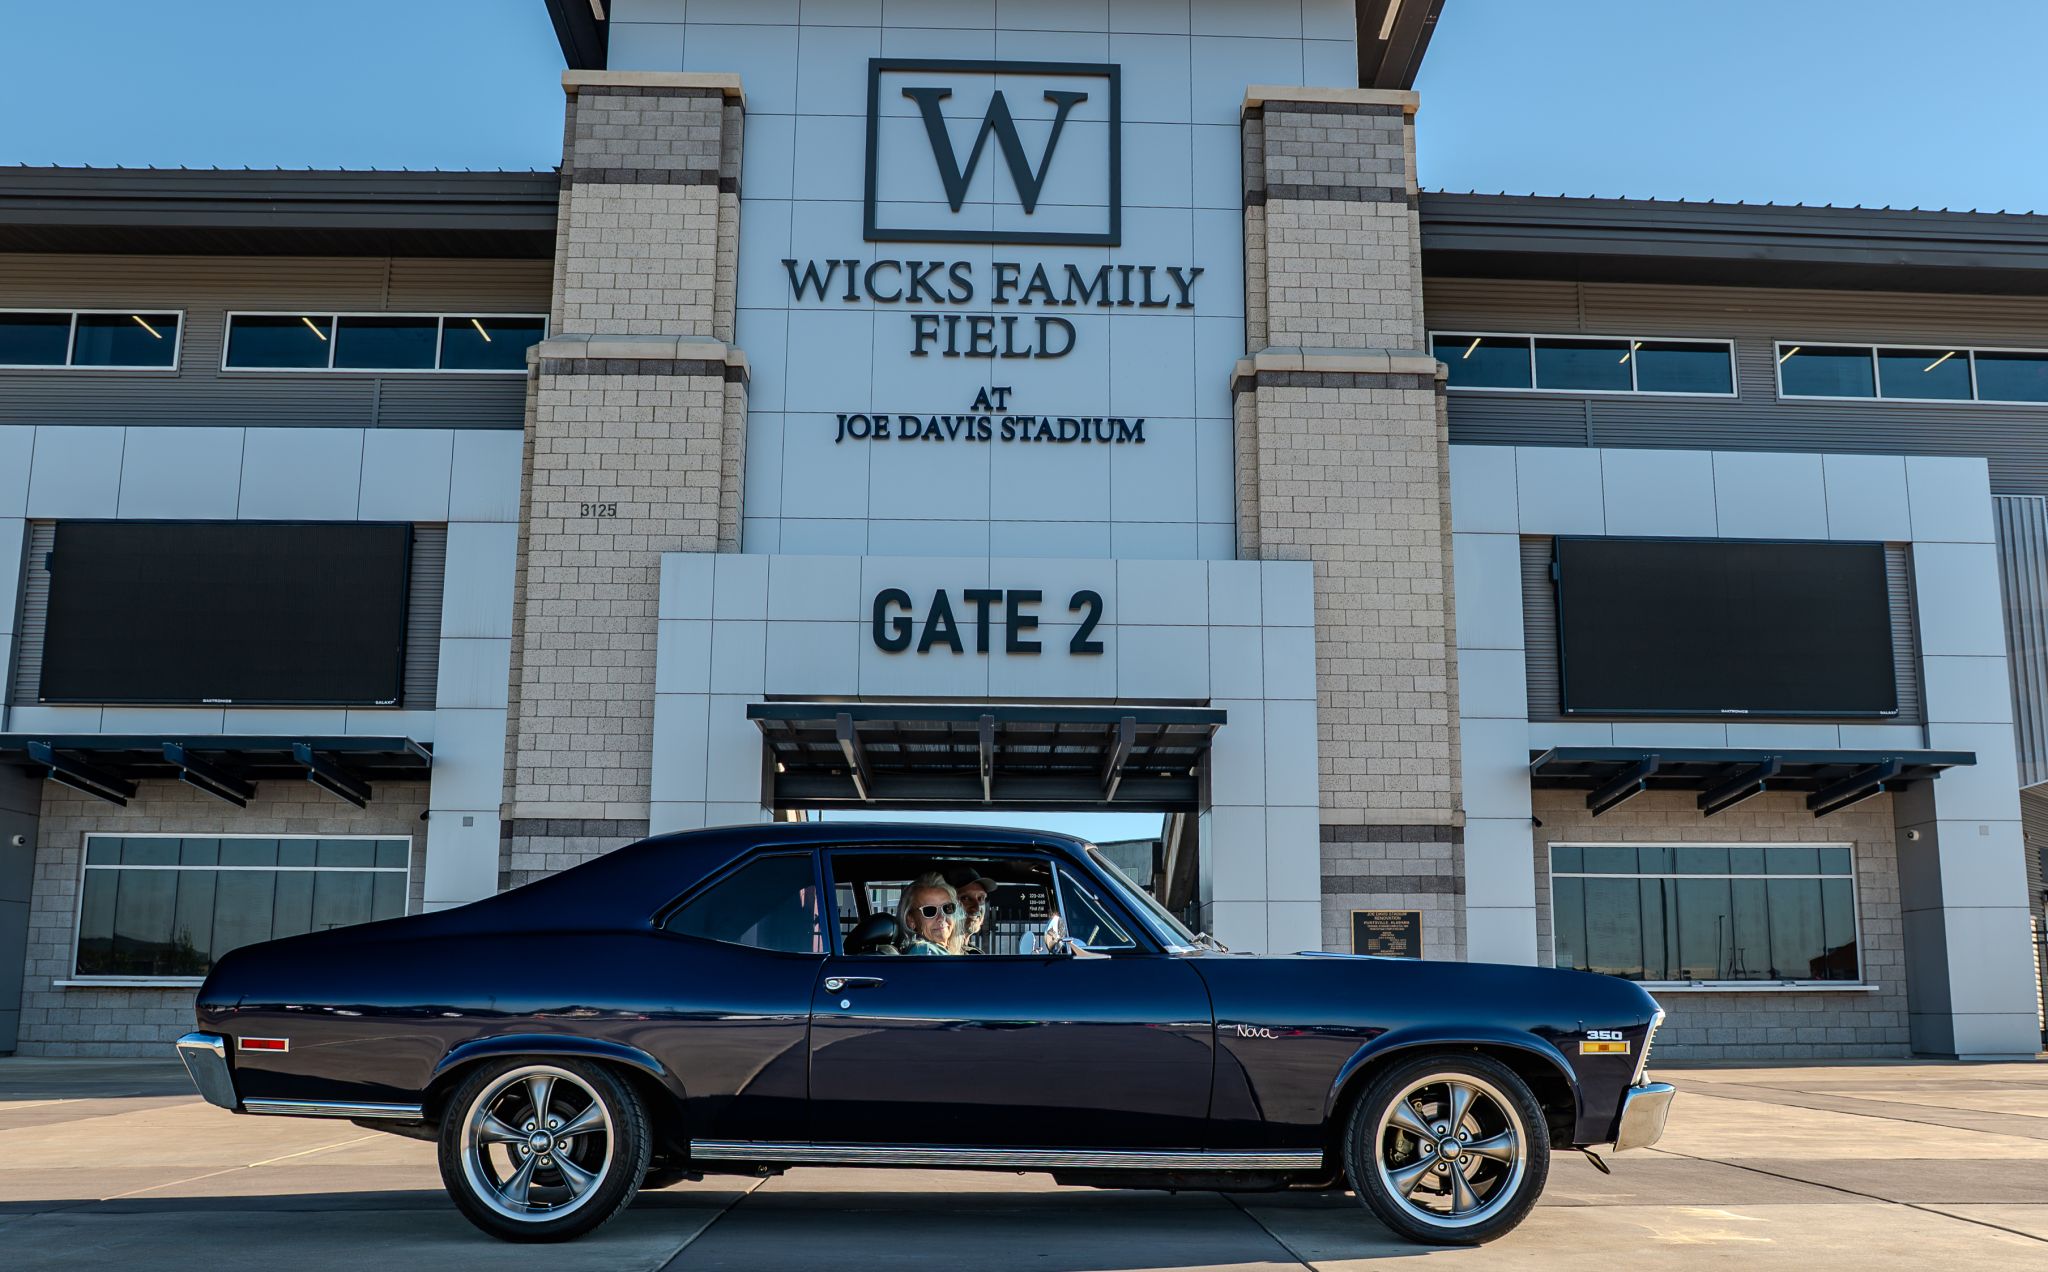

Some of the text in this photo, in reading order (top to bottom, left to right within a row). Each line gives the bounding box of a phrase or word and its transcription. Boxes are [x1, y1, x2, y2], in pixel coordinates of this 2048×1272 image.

[902, 87, 1088, 214] W
[781, 258, 1205, 309] WICKS FAMILY
[910, 314, 1077, 359] FIELD
[970, 385, 1012, 412] AT
[835, 414, 1146, 444] JOE DAVIS STADIUM
[581, 503, 616, 517] 3125
[872, 588, 1104, 655] GATE 2
[1237, 1023, 1279, 1040] Nova
[1587, 1030, 1623, 1040] 350
